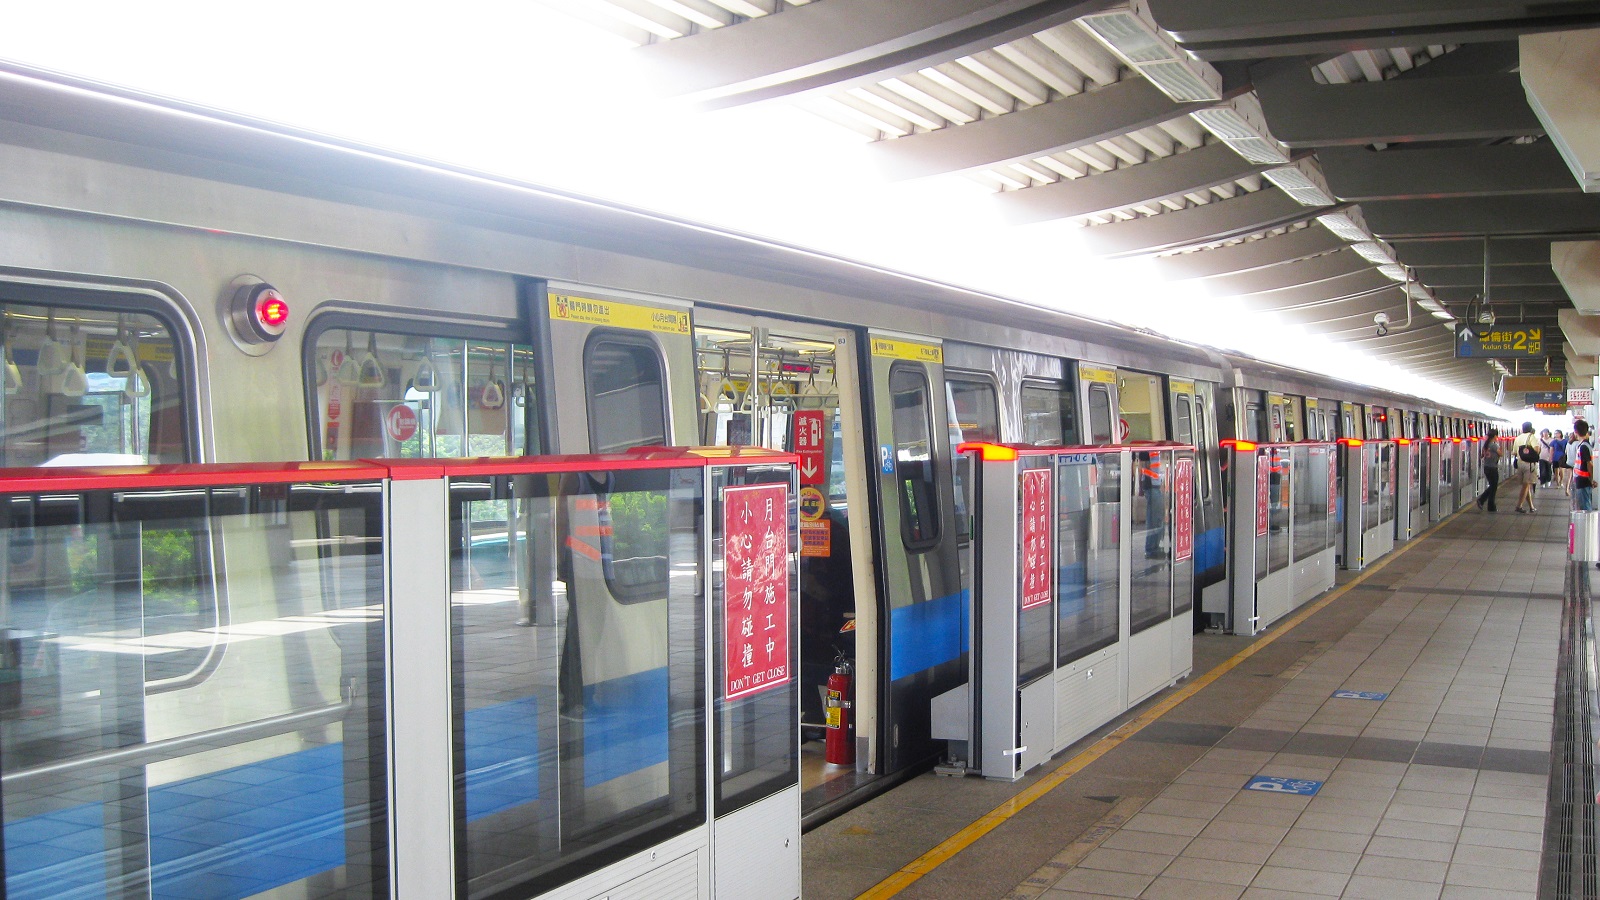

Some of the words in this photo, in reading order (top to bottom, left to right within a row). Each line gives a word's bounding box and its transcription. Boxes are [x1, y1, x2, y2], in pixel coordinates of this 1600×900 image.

[1513, 330, 1527, 350] 2
[798, 416, 808, 446] 滅火器
[881, 446, 888, 467] P
[740, 501, 754, 668] 小心請勿碰撞
[764, 497, 776, 662] 月台門施工中
[730, 675, 751, 691] DON'T
[752, 671, 765, 685] GET
[766, 665, 786, 680] CLOSE
[1249, 781, 1299, 793] P
